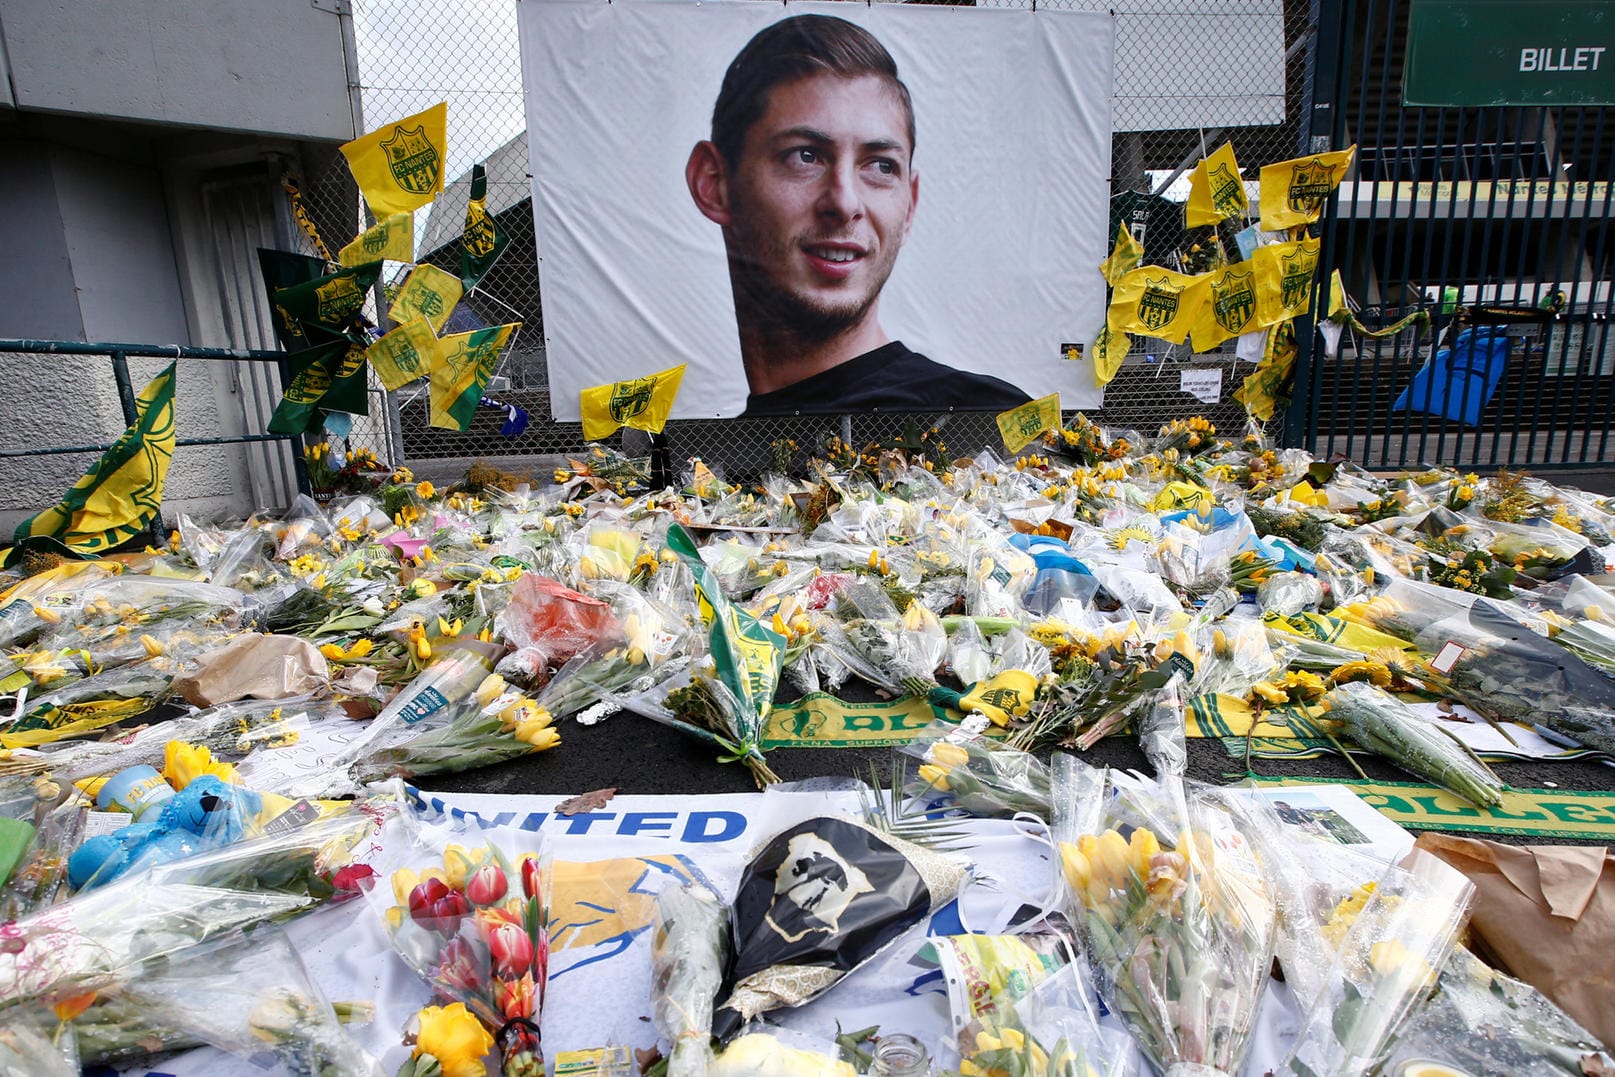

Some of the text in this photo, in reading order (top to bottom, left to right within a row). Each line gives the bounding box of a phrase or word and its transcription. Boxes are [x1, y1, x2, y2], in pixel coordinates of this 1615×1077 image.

[1519, 47, 1606, 72] BILLET
[394, 150, 434, 173] FC NANTES
[1291, 185, 1329, 195] FC NANTES
[1143, 293, 1176, 308] FC NANTES
[613, 398, 623, 407] FC
[126, 786, 145, 804] FC
